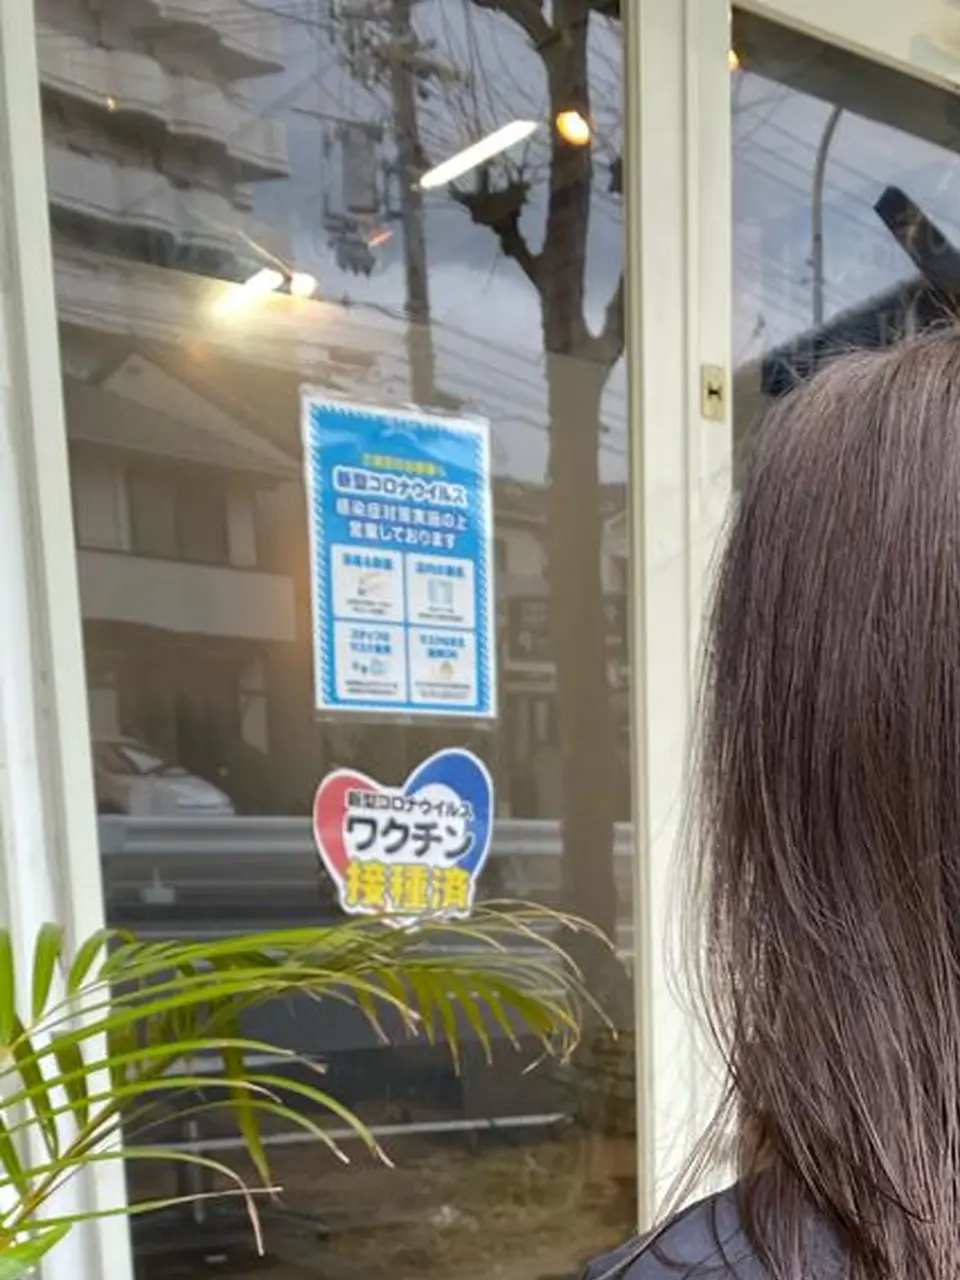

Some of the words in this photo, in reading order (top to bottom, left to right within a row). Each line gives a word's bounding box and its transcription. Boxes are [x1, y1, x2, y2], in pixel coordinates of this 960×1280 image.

[337, 469, 467, 505] 新型コロナウイルス
[348, 790, 474, 820] 新型コロナウイルス
[346, 815, 475, 859] ワクチン
[345, 858, 471, 911] 接種済
